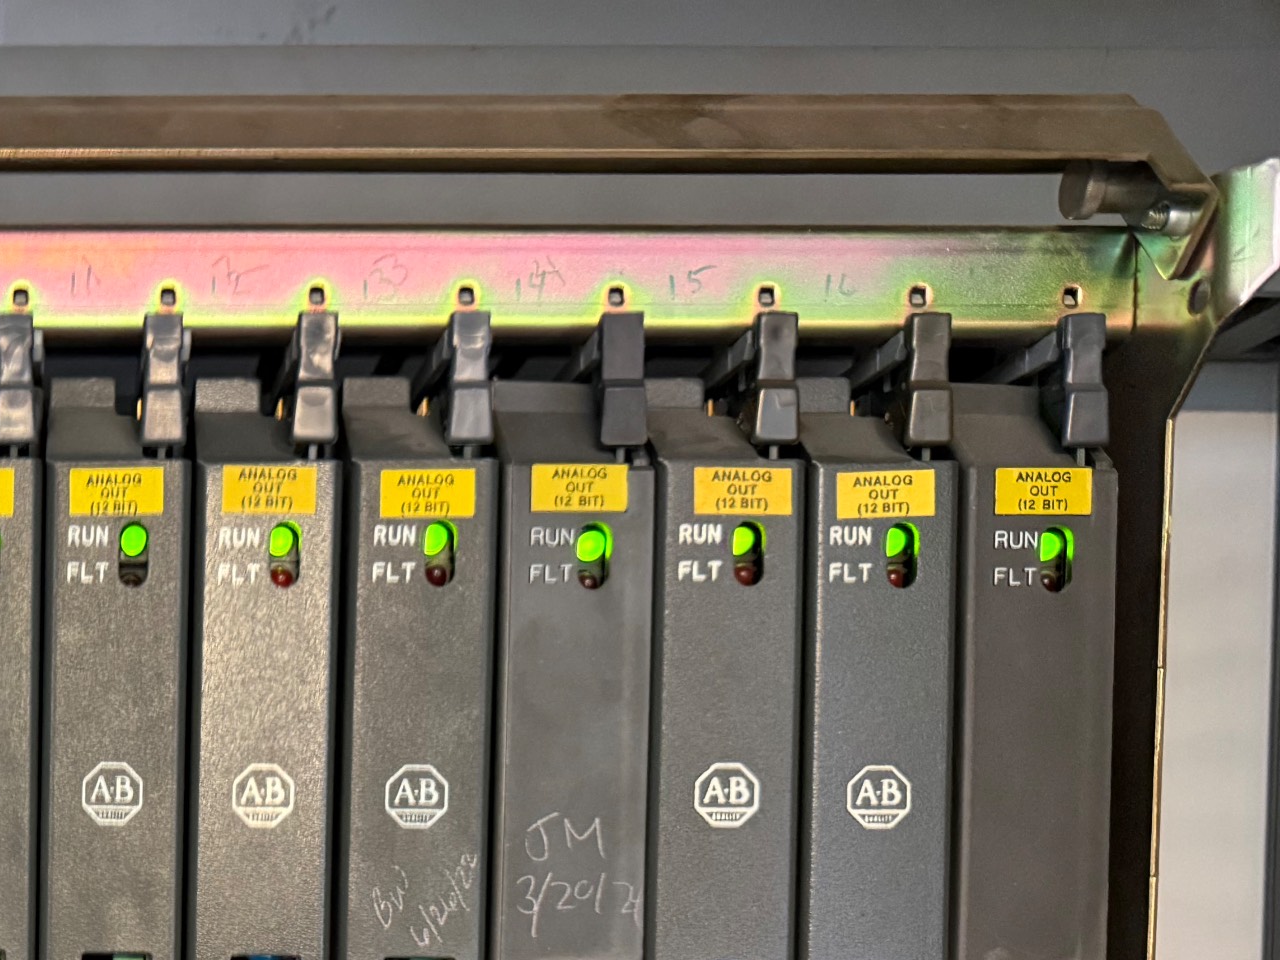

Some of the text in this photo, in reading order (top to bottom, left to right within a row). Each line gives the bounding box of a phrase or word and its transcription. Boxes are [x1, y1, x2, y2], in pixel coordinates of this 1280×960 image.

[670, 265, 717, 300] 15
[87, 473, 142, 487] ANALOG
[239, 468, 297, 481] ANALOG
[398, 474, 454, 487] ANALOG
[552, 467, 607, 481] ANALOG
[712, 470, 772, 483] ANALOG
[853, 475, 912, 487] ANALOG
[1016, 472, 1071, 482] ANALOG
[100, 487, 128, 499] OUT
[252, 482, 282, 494] OUT
[411, 487, 439, 499] OUT
[565, 481, 594, 493] OUT
[727, 484, 757, 495] OUT
[1030, 486, 1058, 496] OUT
[554, 495, 604, 508] (12 BIT)
[868, 489, 899, 500] OUT
[91, 500, 137, 516] (12 BIT)
[241, 496, 293, 510] (12 BIT)
[401, 501, 449, 517] (12 BIT)
[716, 497, 768, 510] (12 BIT)
[858, 502, 910, 514] (12 BIT)
[1019, 499, 1068, 511] (12 BIT)
[68, 525, 109, 547] RUN
[220, 526, 260, 549] RUN
[374, 525, 417, 546] RUN
[531, 527, 574, 546] RUN
[679, 524, 721, 544] RUN
[830, 526, 872, 545] RUN
[995, 531, 1038, 549] RUN
[67, 561, 108, 584] FLT
[220, 563, 260, 586] FLT
[373, 561, 417, 583] FLT
[530, 563, 573, 584] FLT
[678, 560, 722, 582] FLT
[829, 563, 872, 583] FLT
[995, 568, 1037, 586] FLT
